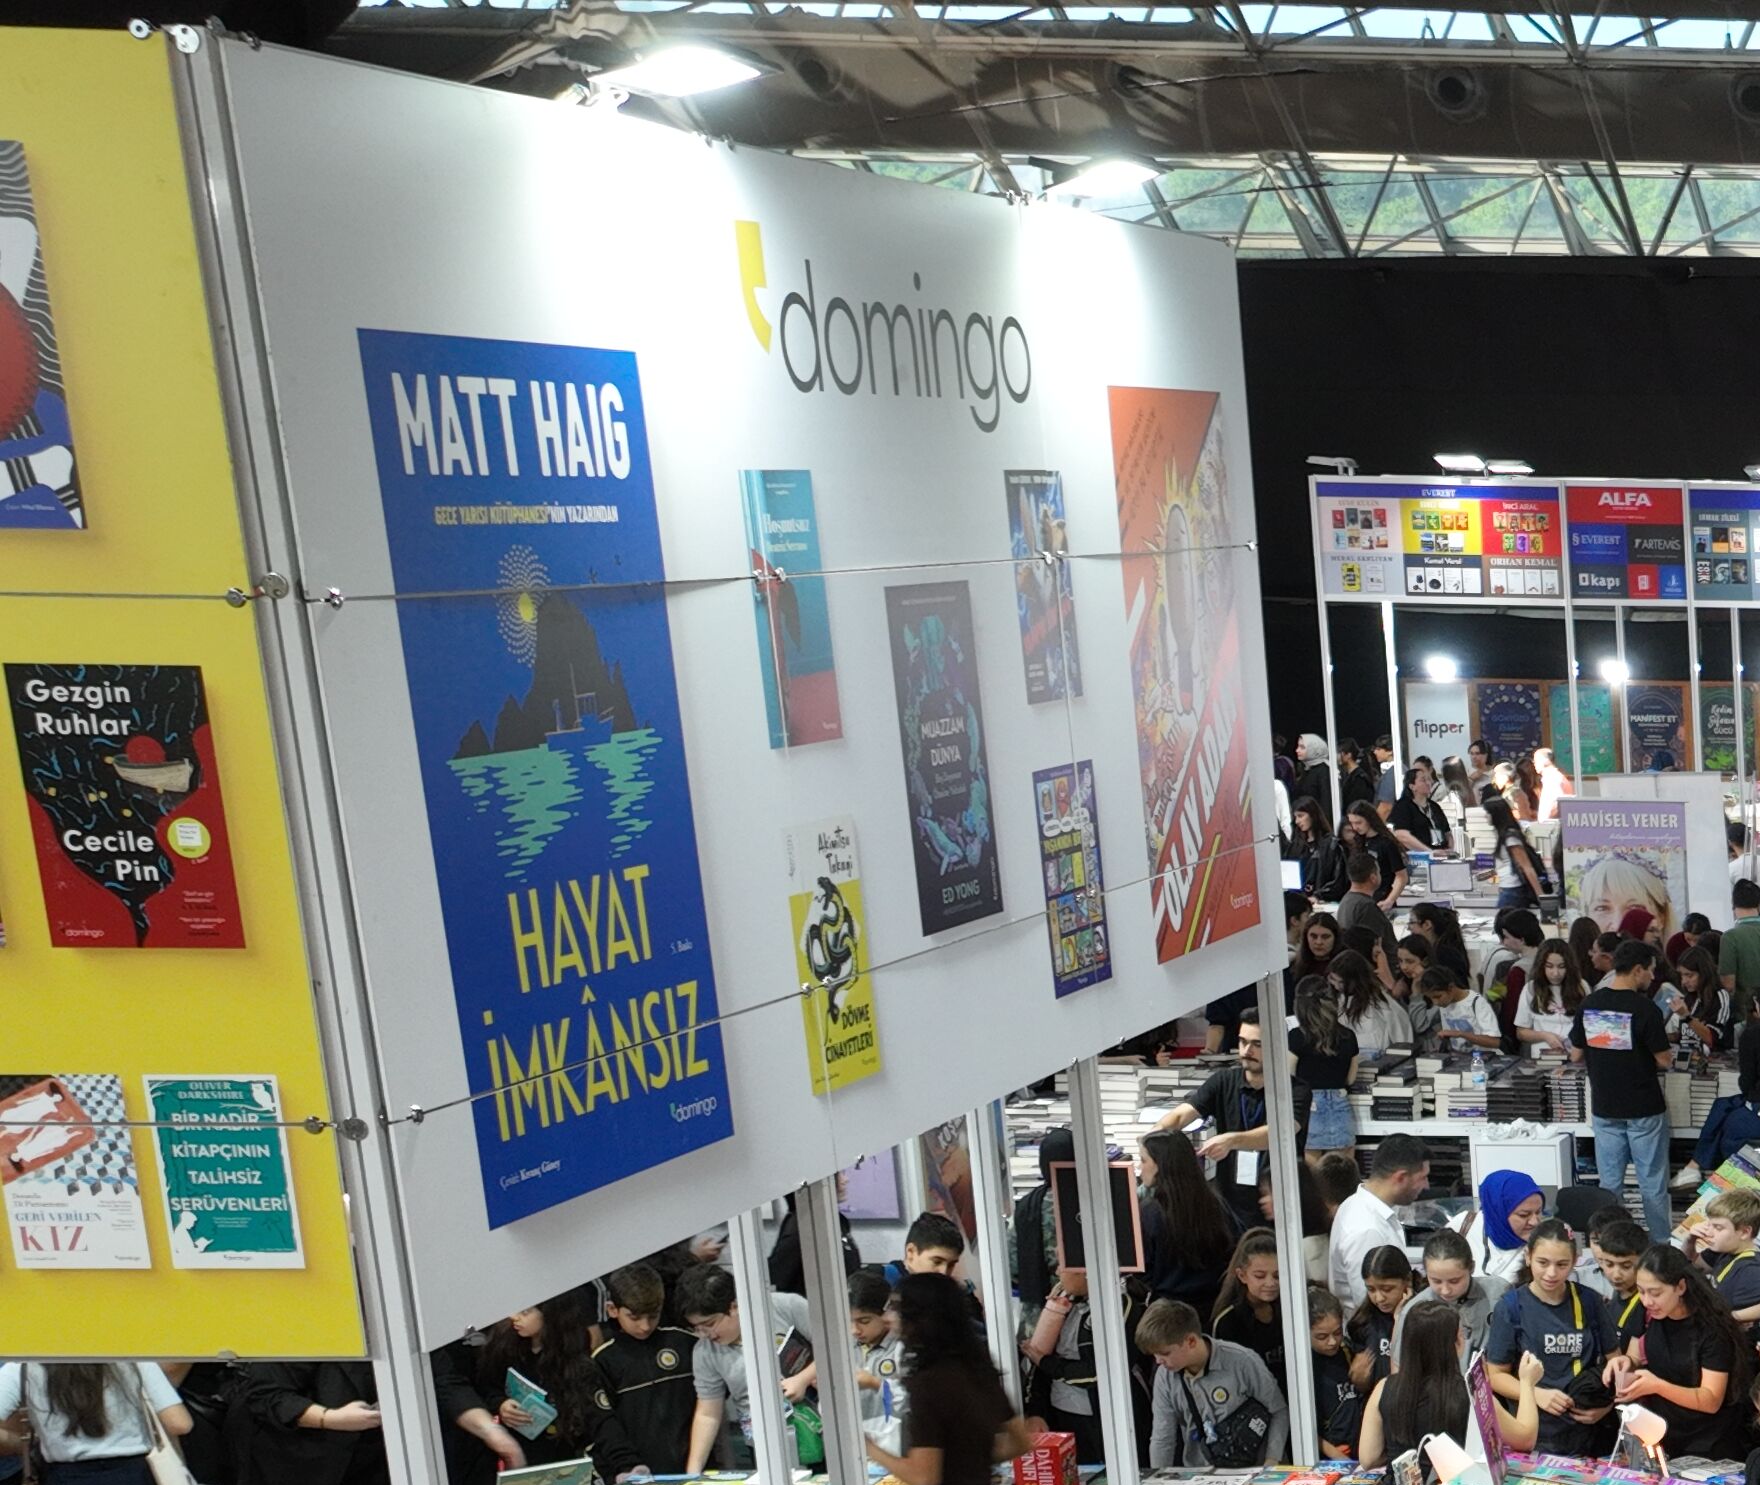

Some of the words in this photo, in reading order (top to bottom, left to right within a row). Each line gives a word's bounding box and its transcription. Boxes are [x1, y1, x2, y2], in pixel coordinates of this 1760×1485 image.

[779, 258, 1032, 432] domingo
[391, 372, 517, 476] MATT
[530, 380, 632, 480] HAIG
[1421, 489, 1457, 498] EVEREST
[1598, 492, 1652, 507] ALFA
[1581, 534, 1621, 545] EVEREST
[1490, 558, 1522, 566] ORHAN
[1524, 558, 1558, 567] KEMAL
[25, 679, 131, 709] Gezgin
[35, 712, 131, 736] Ruhlar
[920, 715, 966, 740] MUAZZAM
[1413, 719, 1464, 739] flipper
[930, 742, 962, 767] DÜNYA
[1567, 810, 1628, 829] MAVİSEL
[1632, 815, 1678, 830] YENER
[62, 829, 155, 853] Cecile
[114, 858, 160, 882] Pin
[1160, 788, 1201, 934] OLAY
[942, 886, 955, 905] ED
[954, 880, 981, 902] YONG
[65, 926, 105, 939] domingo
[507, 864, 653, 993] HAYAT
[840, 1004, 870, 1030] DÖVME
[482, 978, 710, 1142] İMKÂNSIZ
[675, 1095, 718, 1123] domingo
[171, 1141, 271, 1161] KİTAPÇININ
[187, 1168, 263, 1185] TALİHSİZ
[170, 1194, 288, 1212] SERÜVENLERİ
